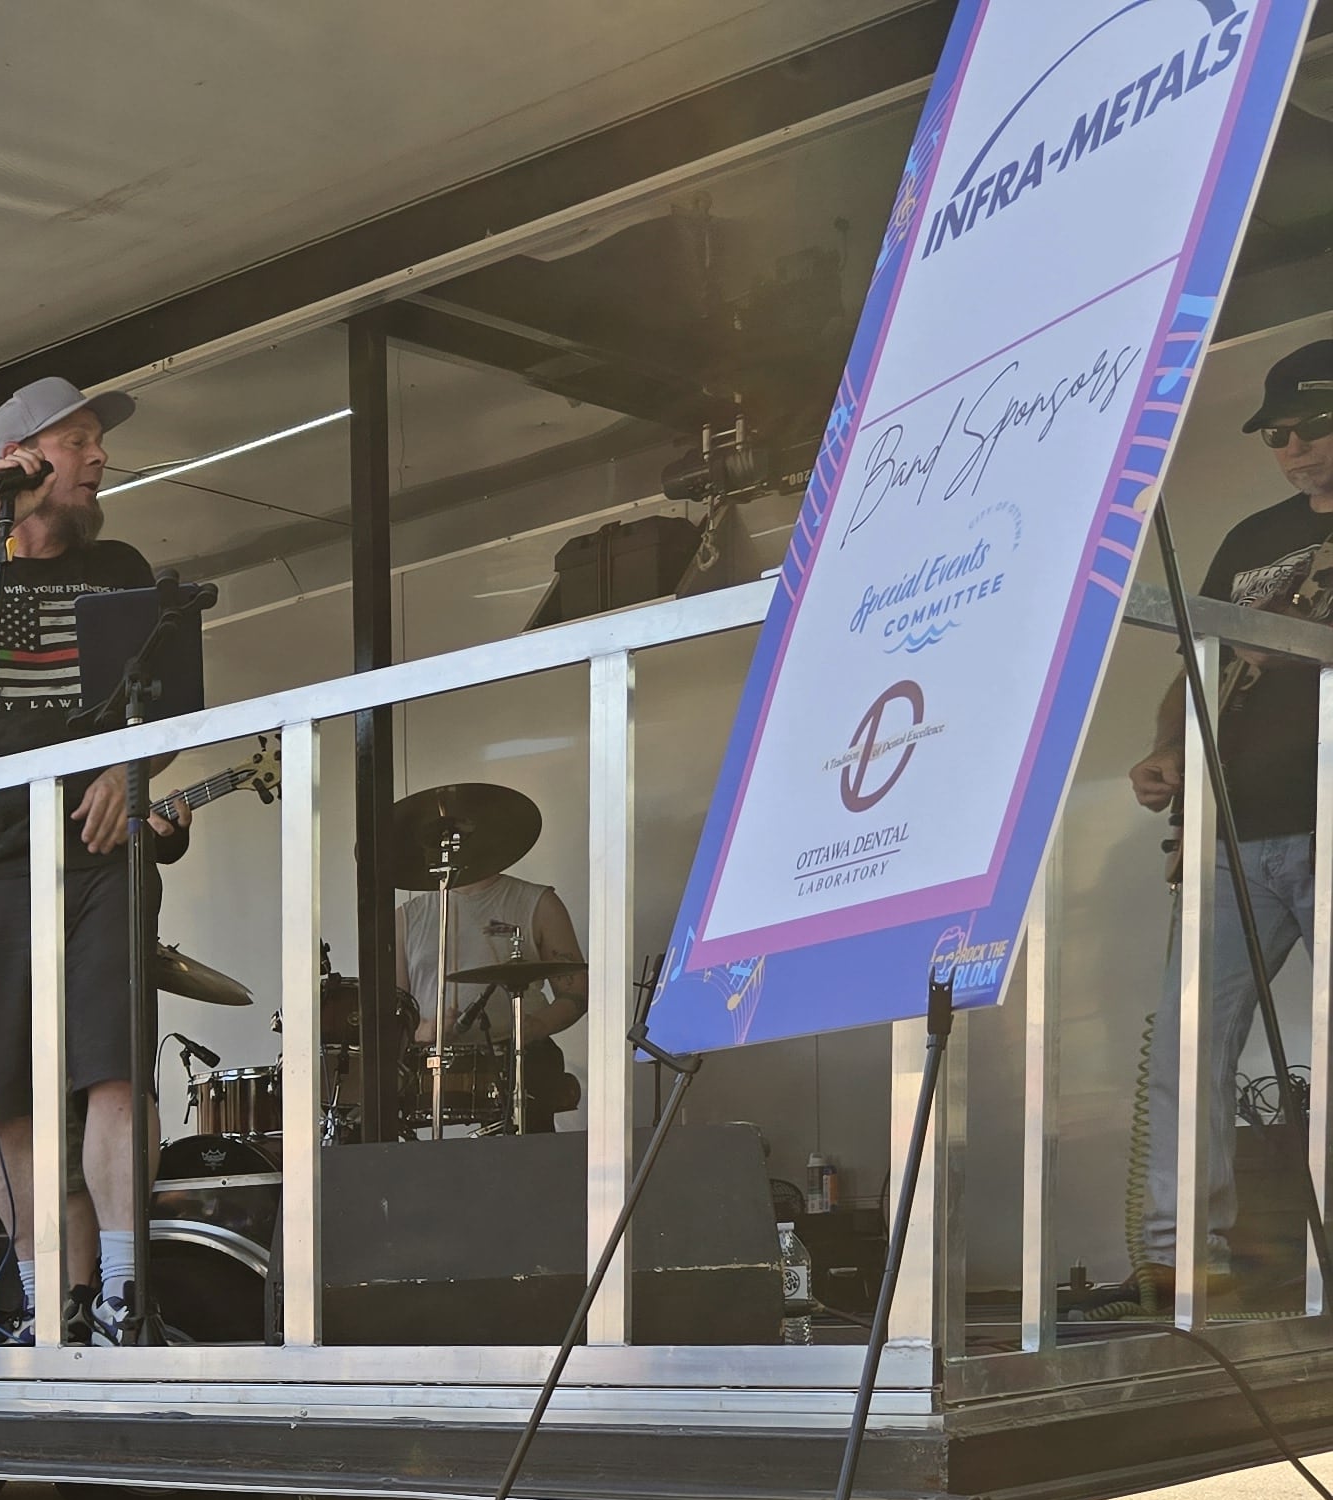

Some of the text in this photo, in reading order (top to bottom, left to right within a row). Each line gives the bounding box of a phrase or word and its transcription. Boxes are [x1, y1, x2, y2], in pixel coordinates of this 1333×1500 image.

[920, 10, 1250, 260] INFRA-METALS
[840, 346, 1141, 550] Band Sponsors
[33, 584, 64, 594] YOUR
[849, 538, 990, 633] Special Events
[884, 573, 1005, 637] COMMITTEE
[796, 822, 909, 870] OTTAWA DENTAL
[797, 859, 889, 897] LABORATORY
[954, 959, 1003, 989] BLOCK
